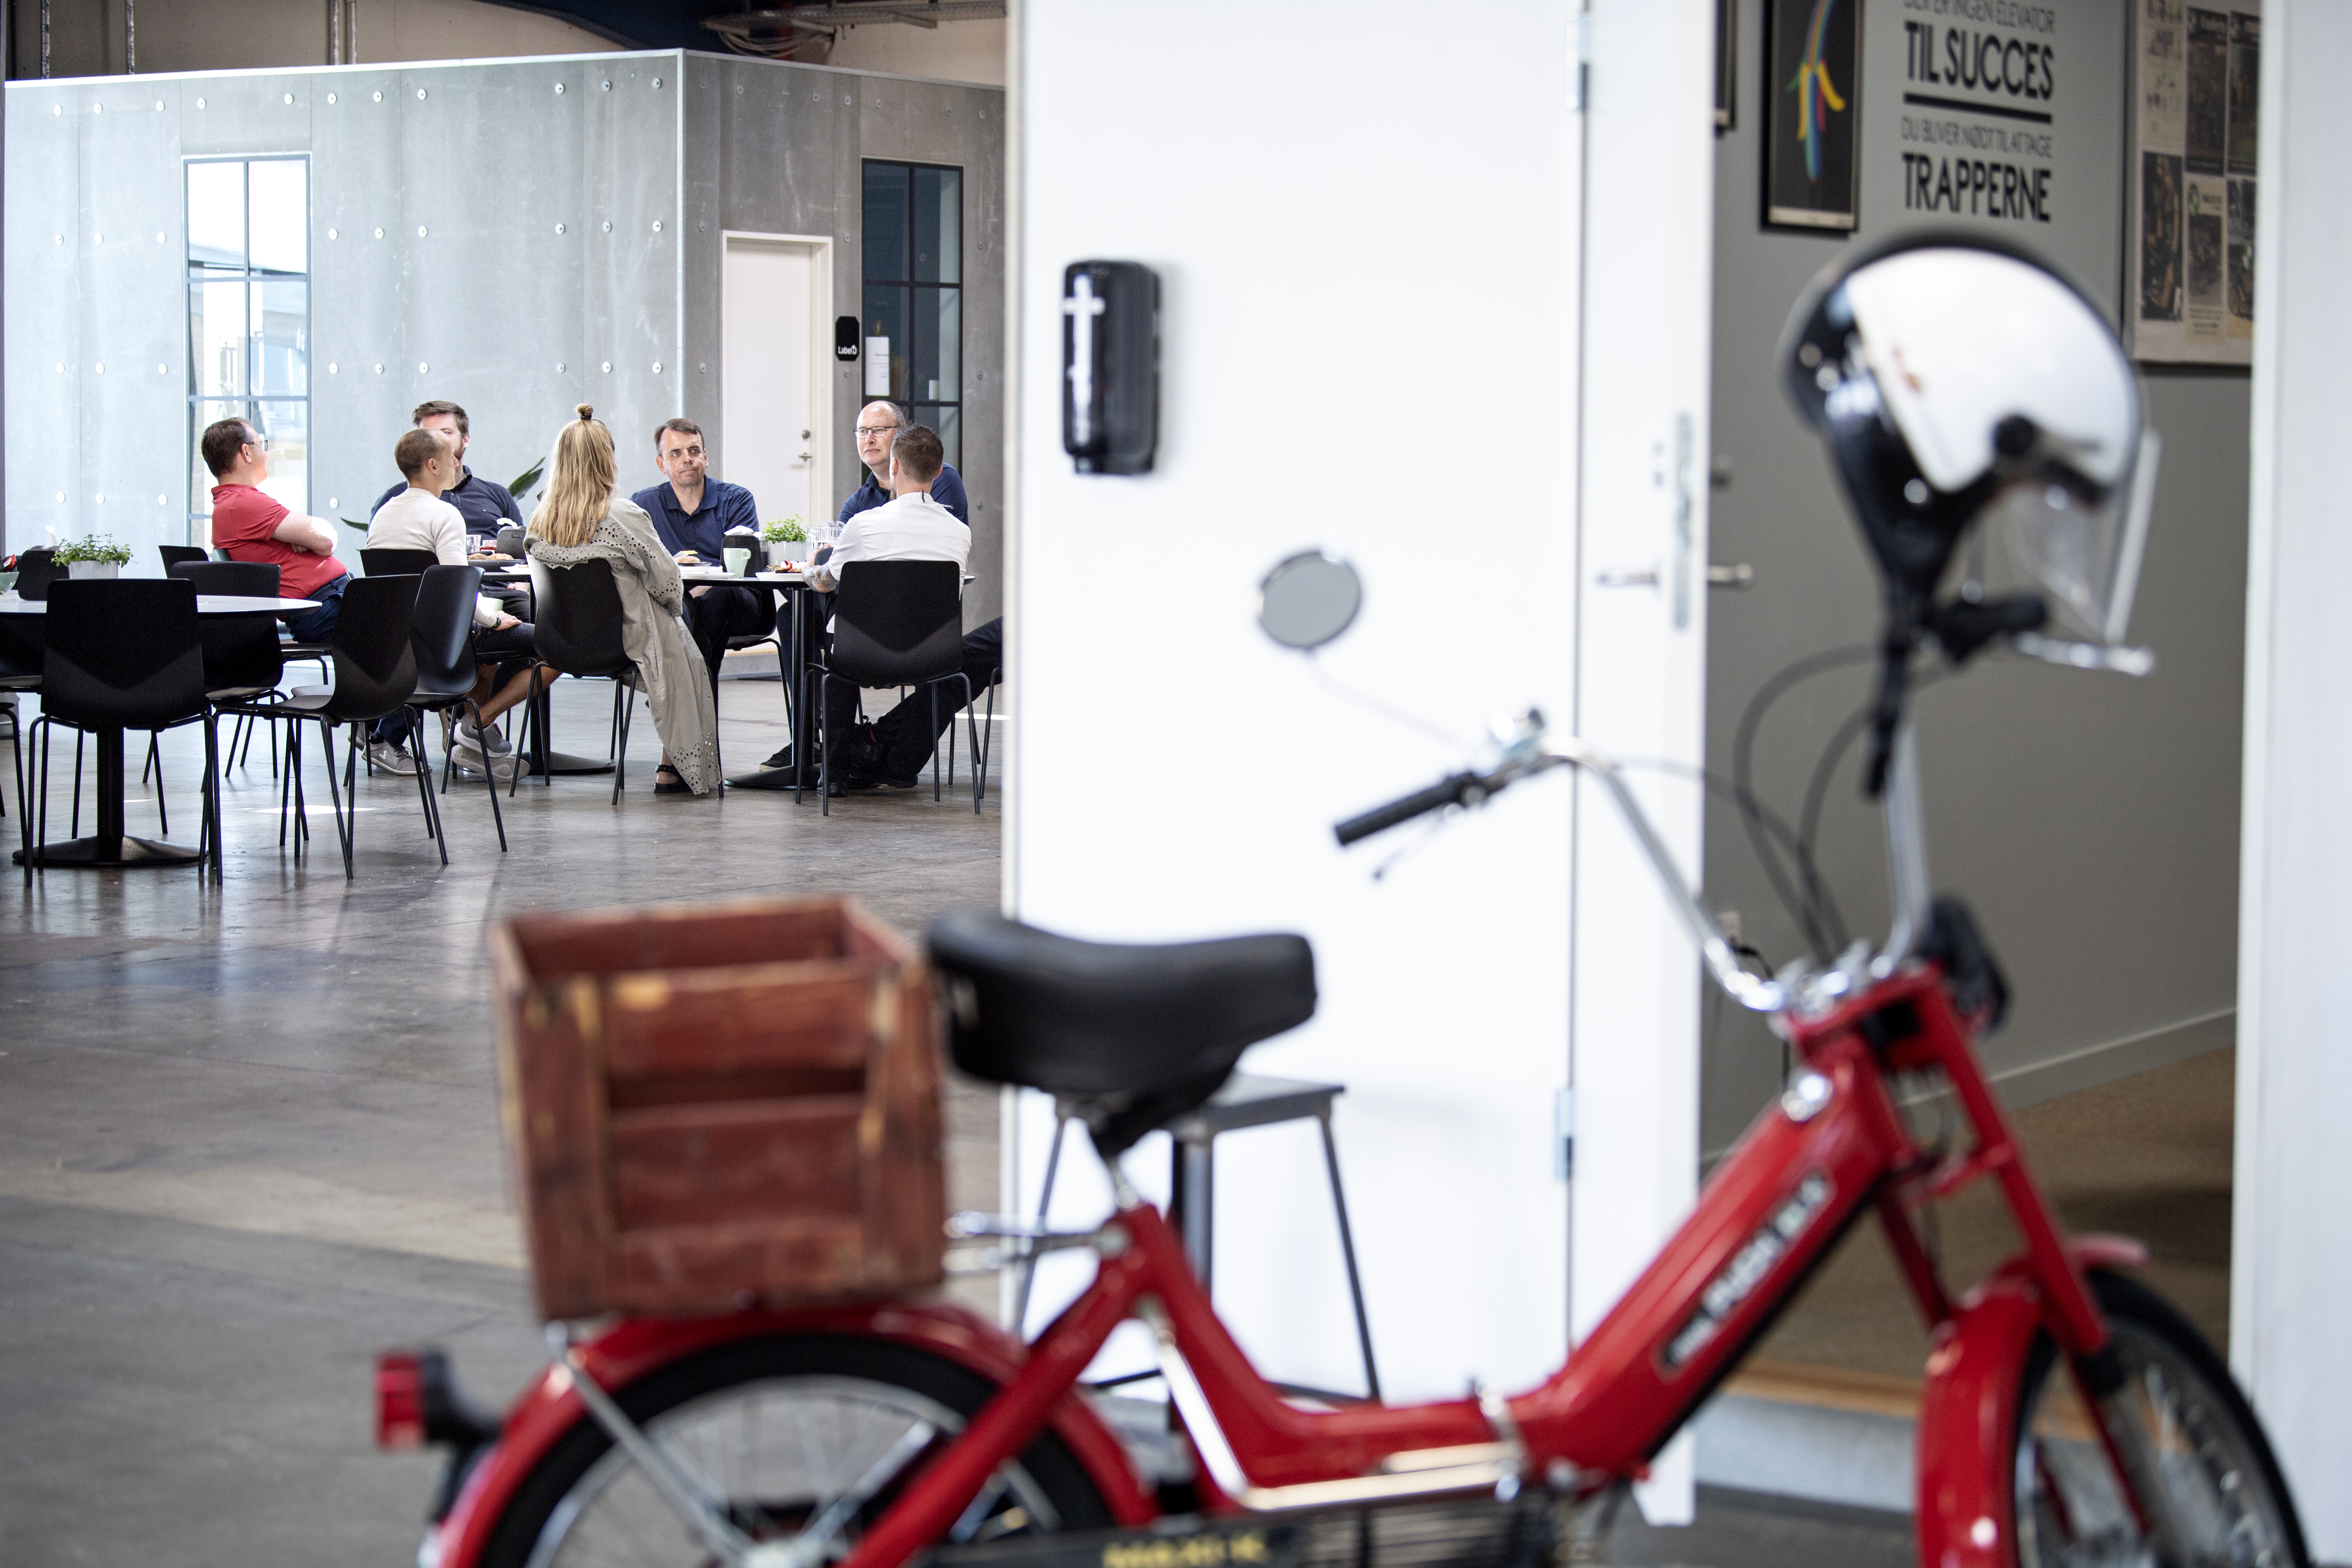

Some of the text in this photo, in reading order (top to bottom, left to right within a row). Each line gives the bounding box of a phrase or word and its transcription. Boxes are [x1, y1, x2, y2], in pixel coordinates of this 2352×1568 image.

[1996, 0, 2055, 34] ELEVATOR
[1904, 19, 2054, 100] TIL SUCCES
[1900, 116, 1919, 141] DU
[1902, 152, 2052, 222] TRAPPERNE
